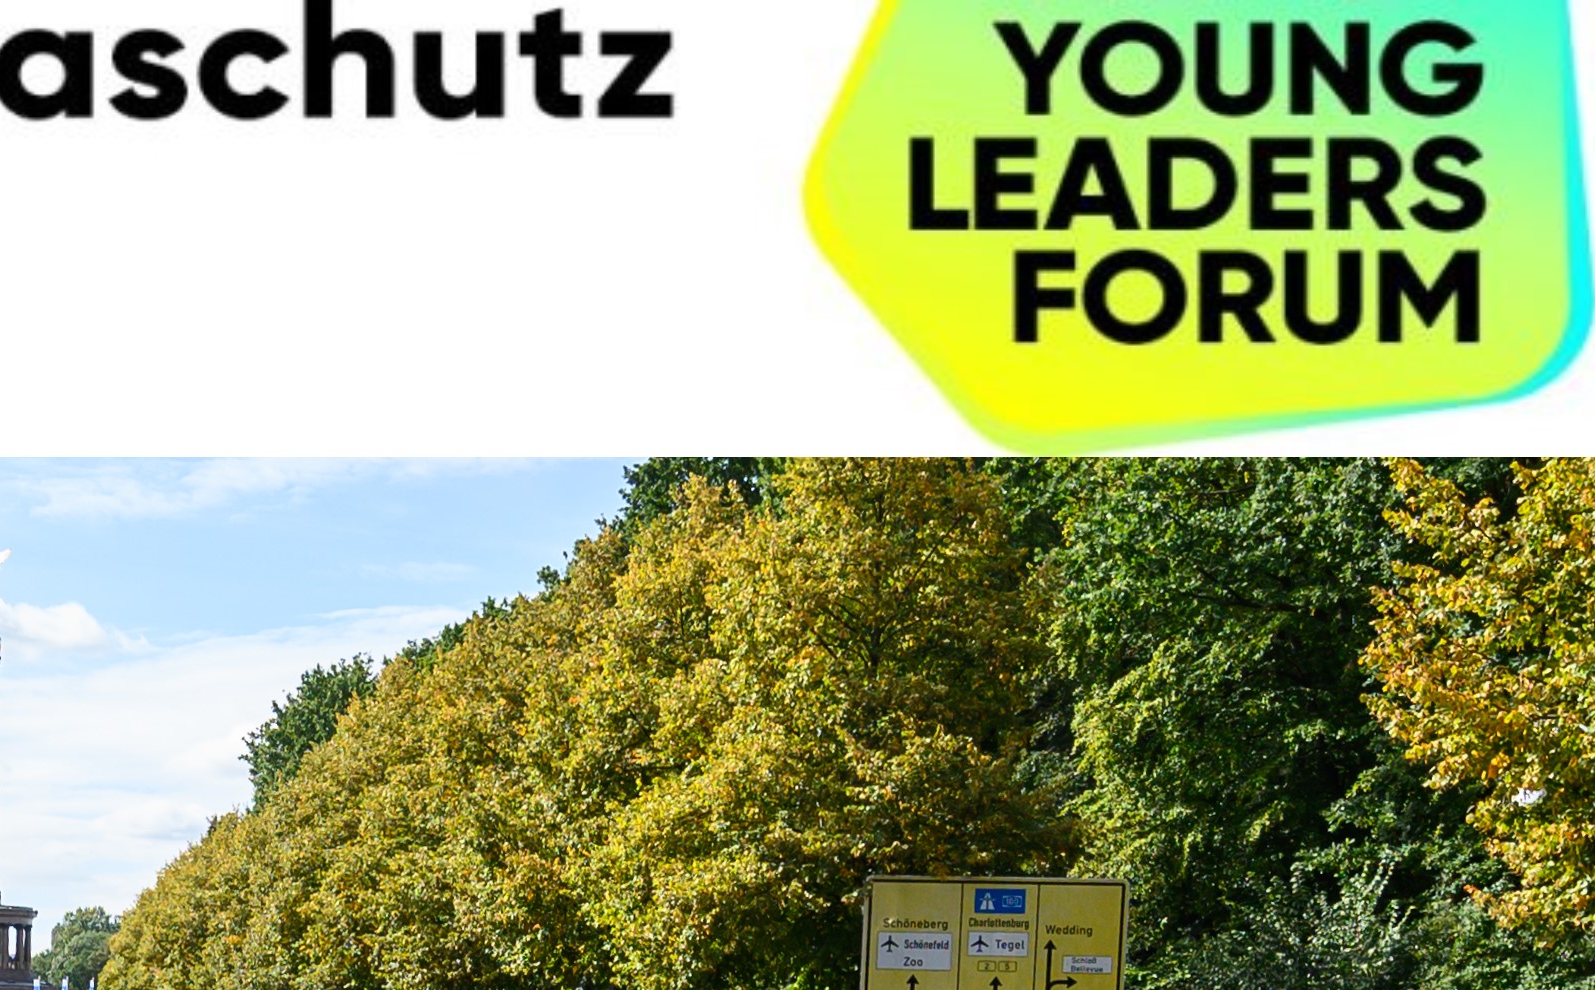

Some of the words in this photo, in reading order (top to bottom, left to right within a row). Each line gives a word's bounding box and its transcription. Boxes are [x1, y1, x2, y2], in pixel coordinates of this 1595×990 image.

[883, 918, 948, 931] Schöneberg
[969, 918, 1029, 931] Charlottenburg
[1045, 924, 1093, 937] Wedding
[904, 939, 949, 950] Schönefeld
[996, 939, 1025, 953] Tegel
[903, 957, 923, 967] Zoo
